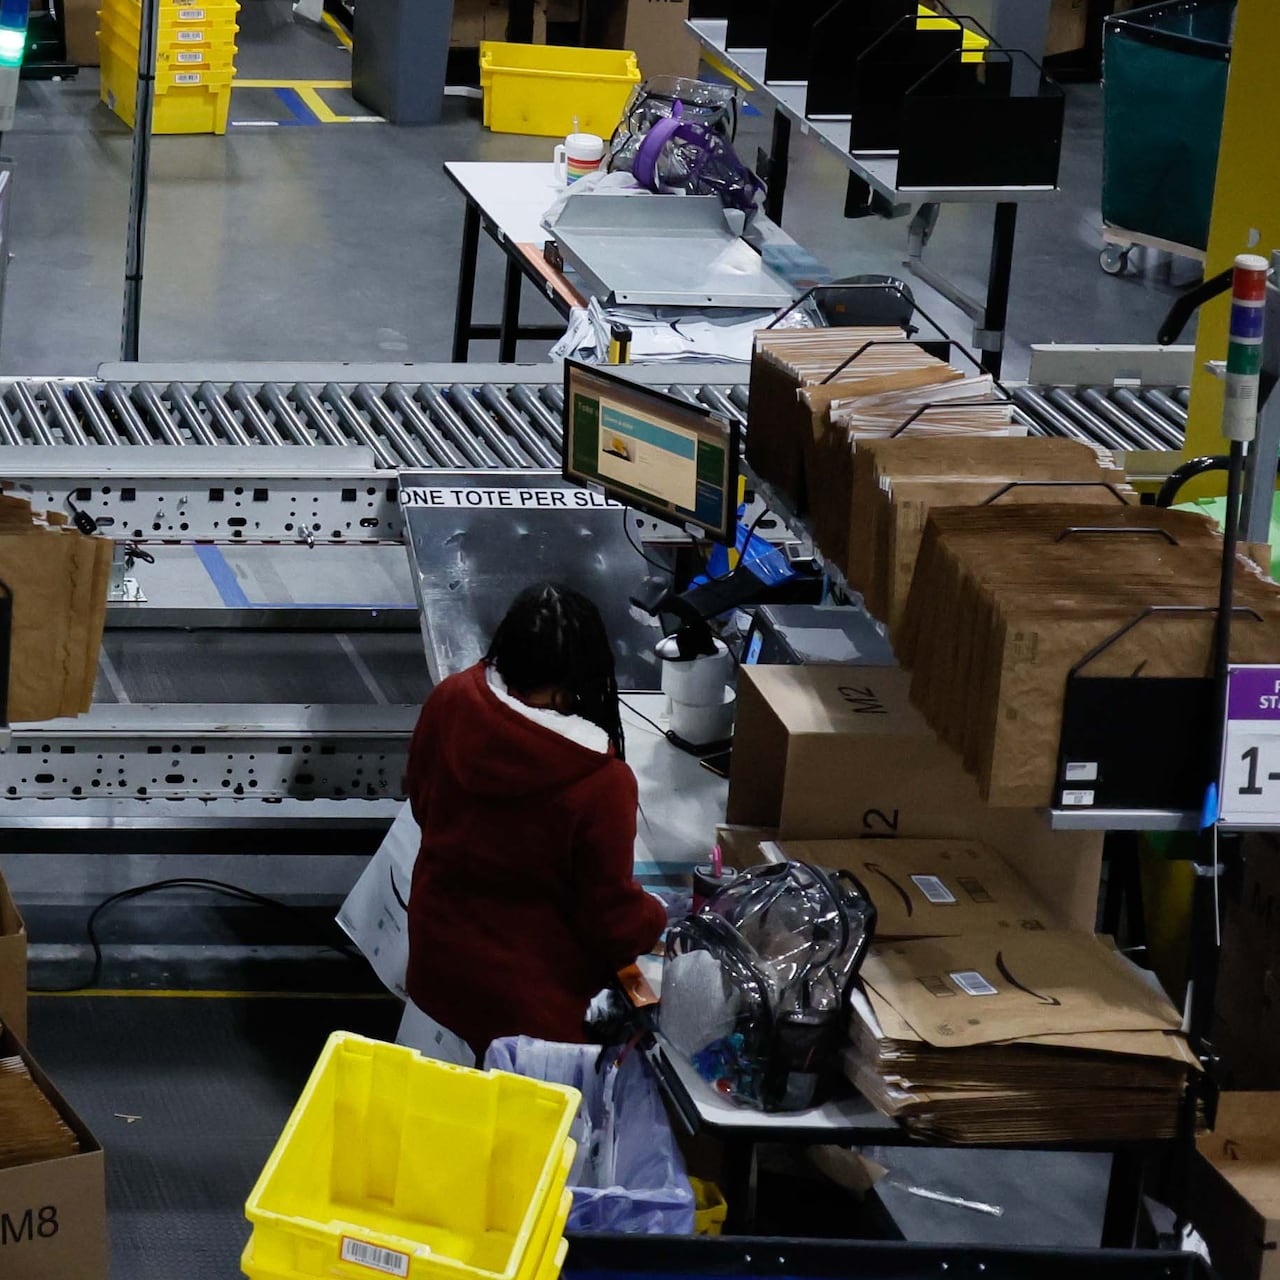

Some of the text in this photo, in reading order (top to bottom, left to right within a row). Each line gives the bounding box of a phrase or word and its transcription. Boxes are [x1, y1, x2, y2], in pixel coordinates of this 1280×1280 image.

[398, 488, 446, 507] ONE
[451, 489, 513, 507] TOTE
[520, 490, 566, 508] PER
[838, 686, 889, 715] M2
[0, 1204, 60, 1246] M8
